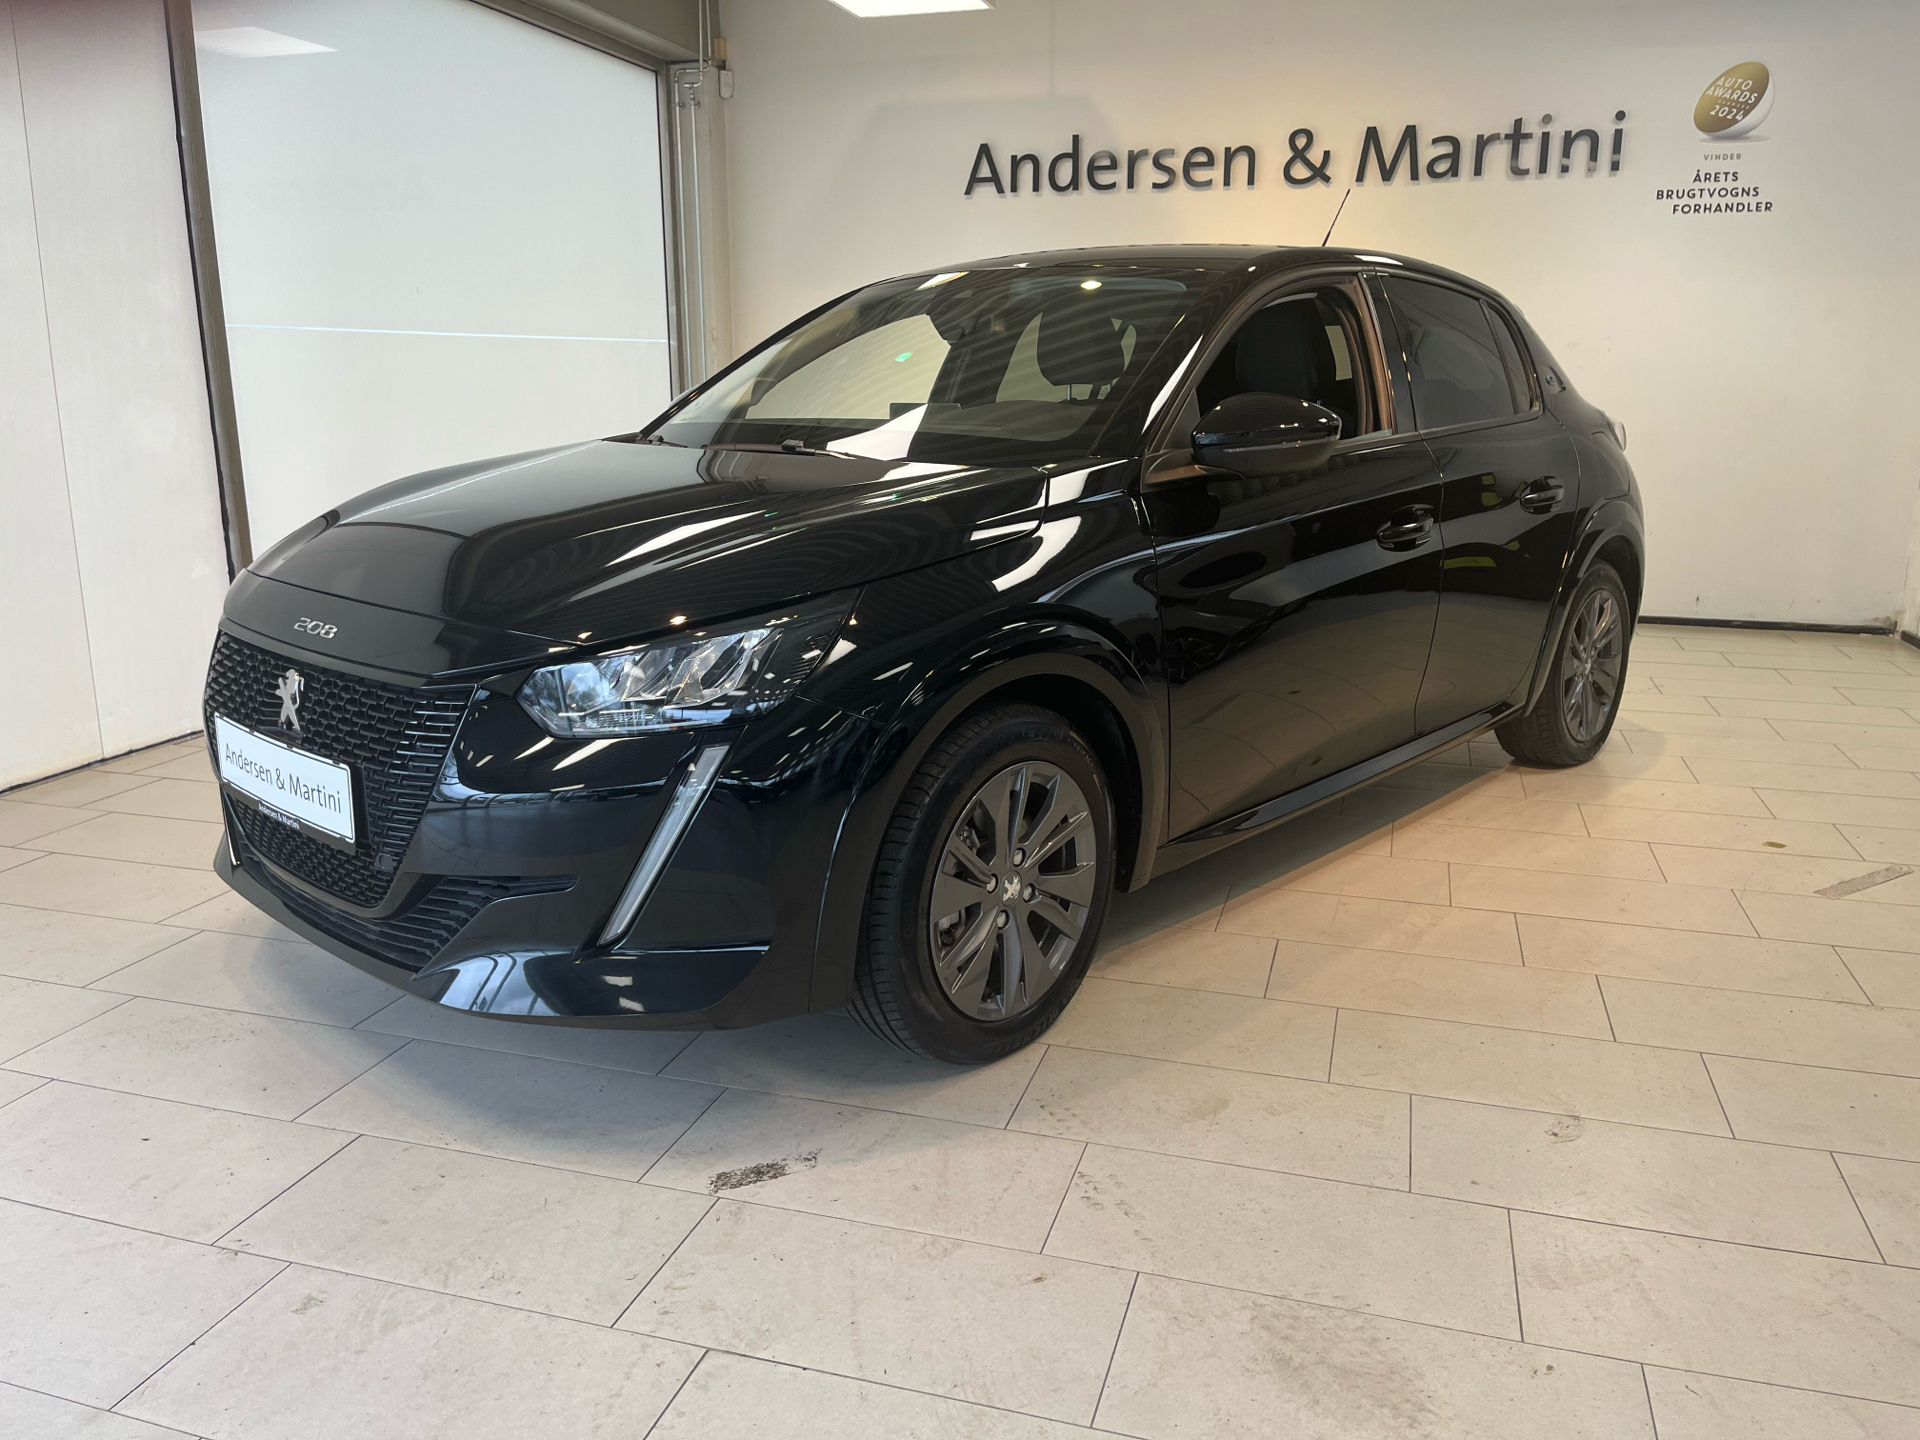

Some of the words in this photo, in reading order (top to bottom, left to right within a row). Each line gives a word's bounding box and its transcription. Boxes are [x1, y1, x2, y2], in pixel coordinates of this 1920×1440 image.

[1715, 76, 1753, 90] AUTO
[1705, 86, 1759, 104] AWARDS
[1709, 104, 1745, 122] 2024
[964, 134, 1257, 197] Andersen
[1282, 127, 1332, 187] &
[1355, 109, 1627, 184] Martini
[1703, 153, 1742, 161] VINDER
[1692, 169, 1739, 183] ÅRETS
[1656, 187, 1760, 200] BRUGTVOGNS
[1672, 202, 1773, 215] FORHANDLER
[293, 617, 338, 639] 208
[225, 743, 273, 786] Andersen
[275, 768, 287, 792] &
[289, 773, 342, 814] Martini
